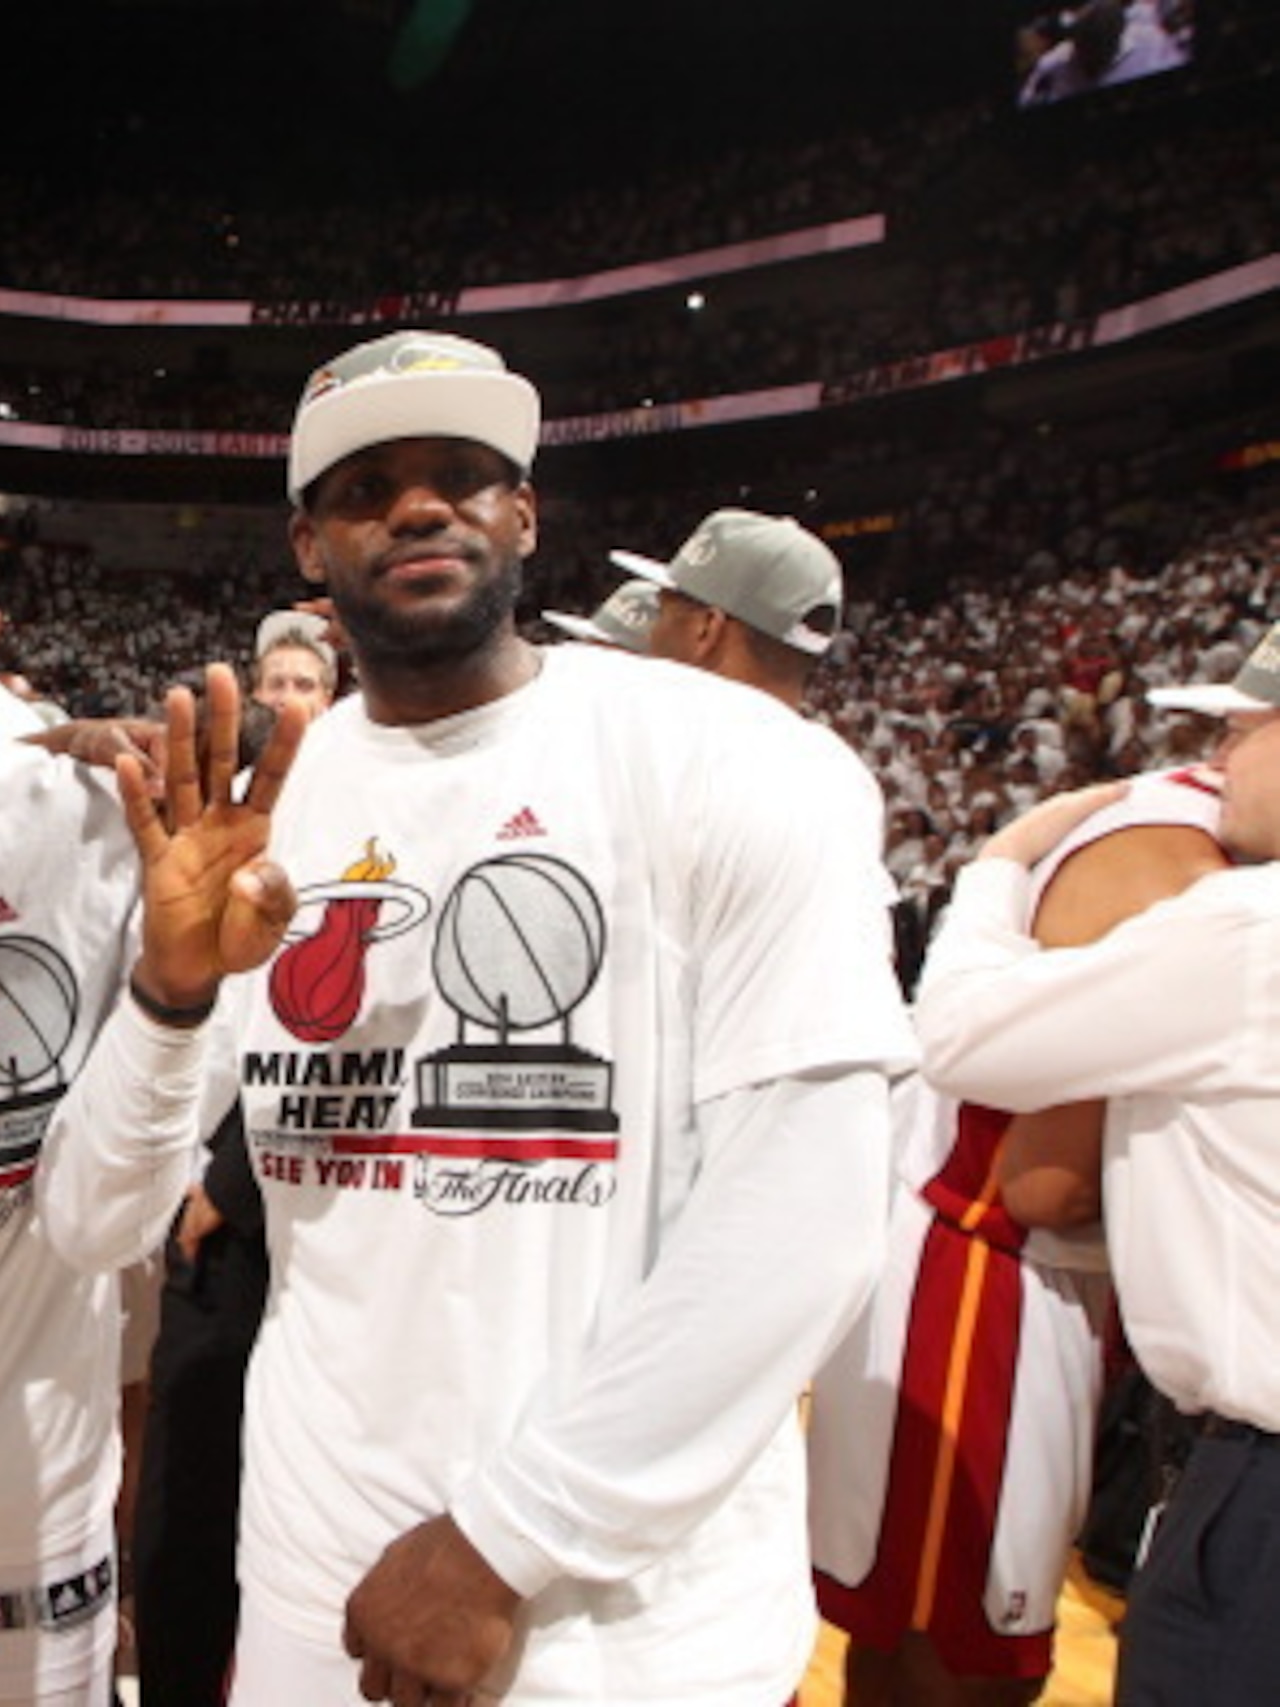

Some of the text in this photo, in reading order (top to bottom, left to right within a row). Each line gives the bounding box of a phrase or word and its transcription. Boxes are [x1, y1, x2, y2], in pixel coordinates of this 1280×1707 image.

[244, 1049, 405, 1086] MIAMI
[261, 1152, 302, 1185] SEE
[371, 1159, 404, 1190] IN
